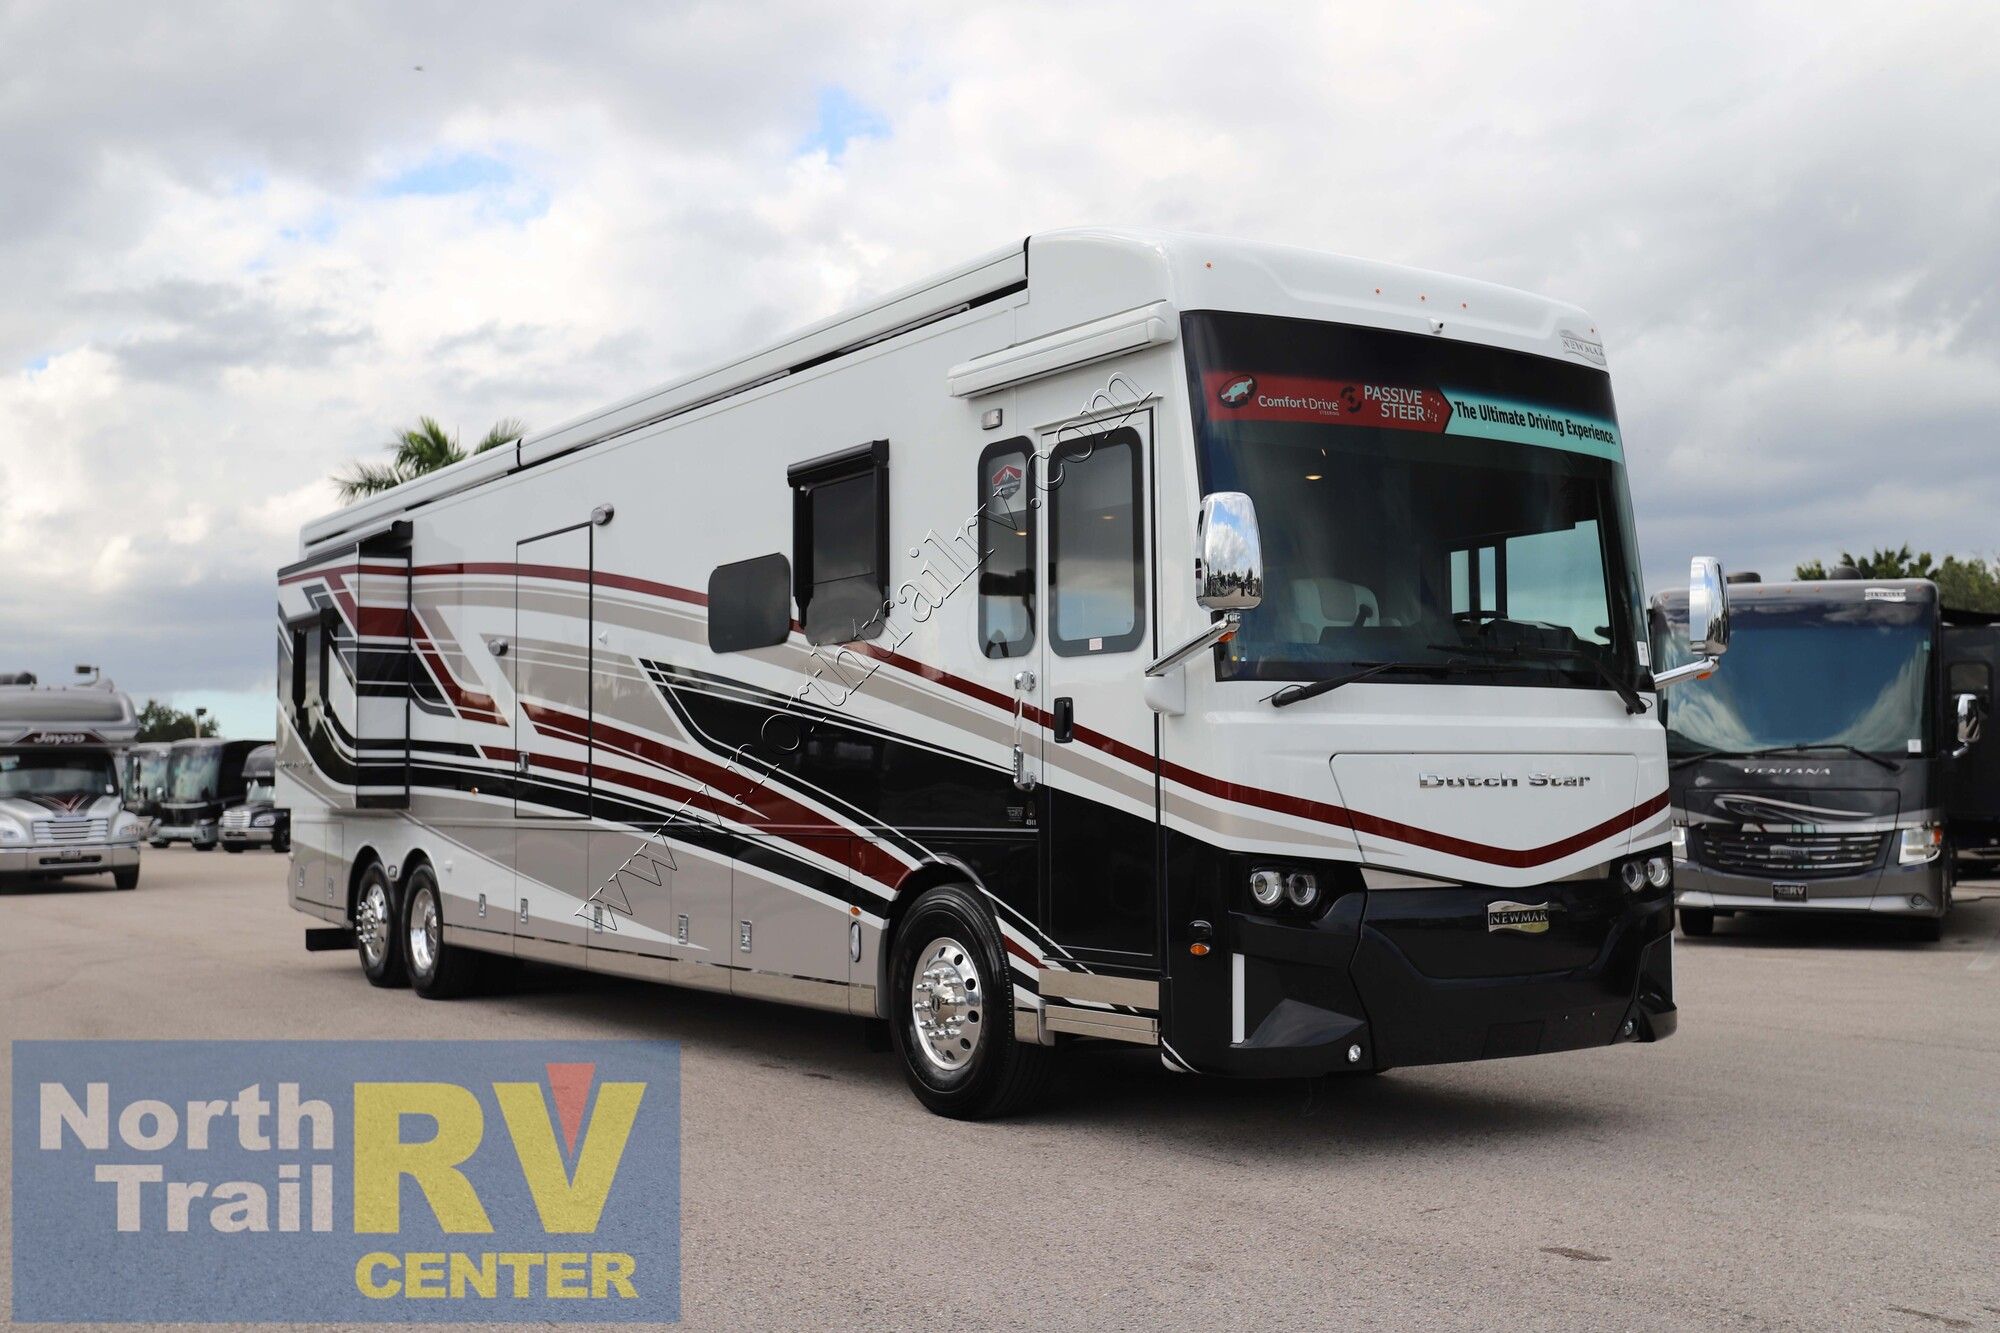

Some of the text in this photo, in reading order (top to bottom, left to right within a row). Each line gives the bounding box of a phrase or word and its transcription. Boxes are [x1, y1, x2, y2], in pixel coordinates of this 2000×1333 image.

[1258, 395, 1339, 411] Comfort Drive
[1364, 385, 1422, 405] PASSIVE
[1380, 403, 1426, 422] STEER
[1454, 401, 1477, 420] The
[1478, 404, 1526, 427] Ultimate
[1527, 413, 1565, 437] Driving
[33, 731, 86, 745] Jayco
[1418, 770, 1591, 789] Dutch Star
[1490, 910, 1548, 925] NEWMAR
